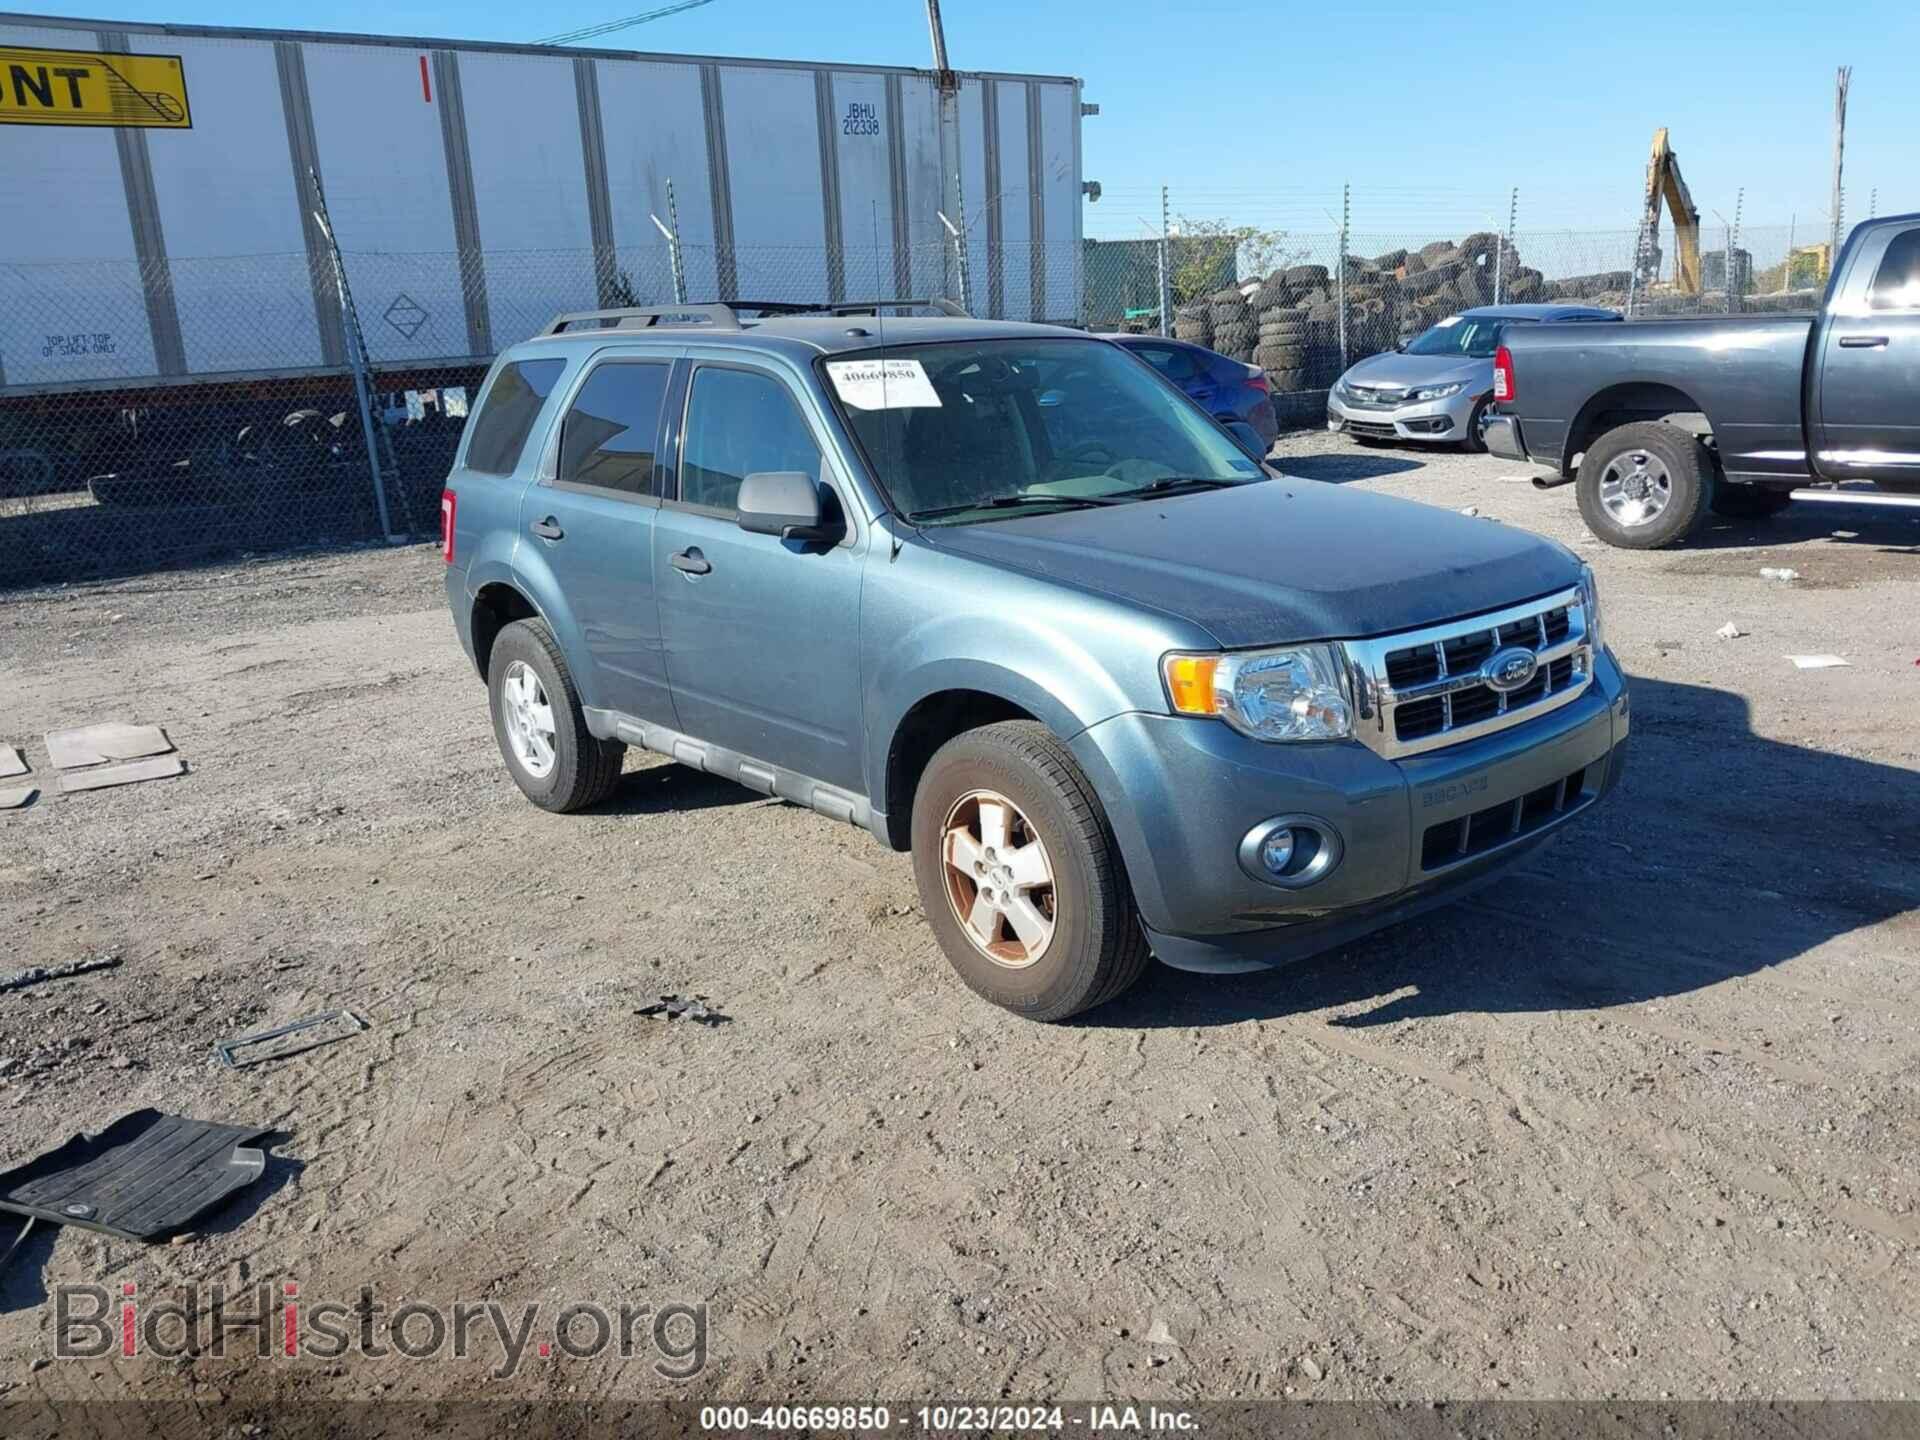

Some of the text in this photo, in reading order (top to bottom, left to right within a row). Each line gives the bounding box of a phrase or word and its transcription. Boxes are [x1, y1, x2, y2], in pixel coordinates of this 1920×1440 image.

[0, 64, 91, 109] NT
[845, 103, 876, 119] JBHU
[842, 118, 880, 136] 212338
[46, 335, 64, 346] TOP
[90, 333, 111, 344] TOP
[42, 346, 55, 357] OF
[93, 343, 116, 354] ONLY
